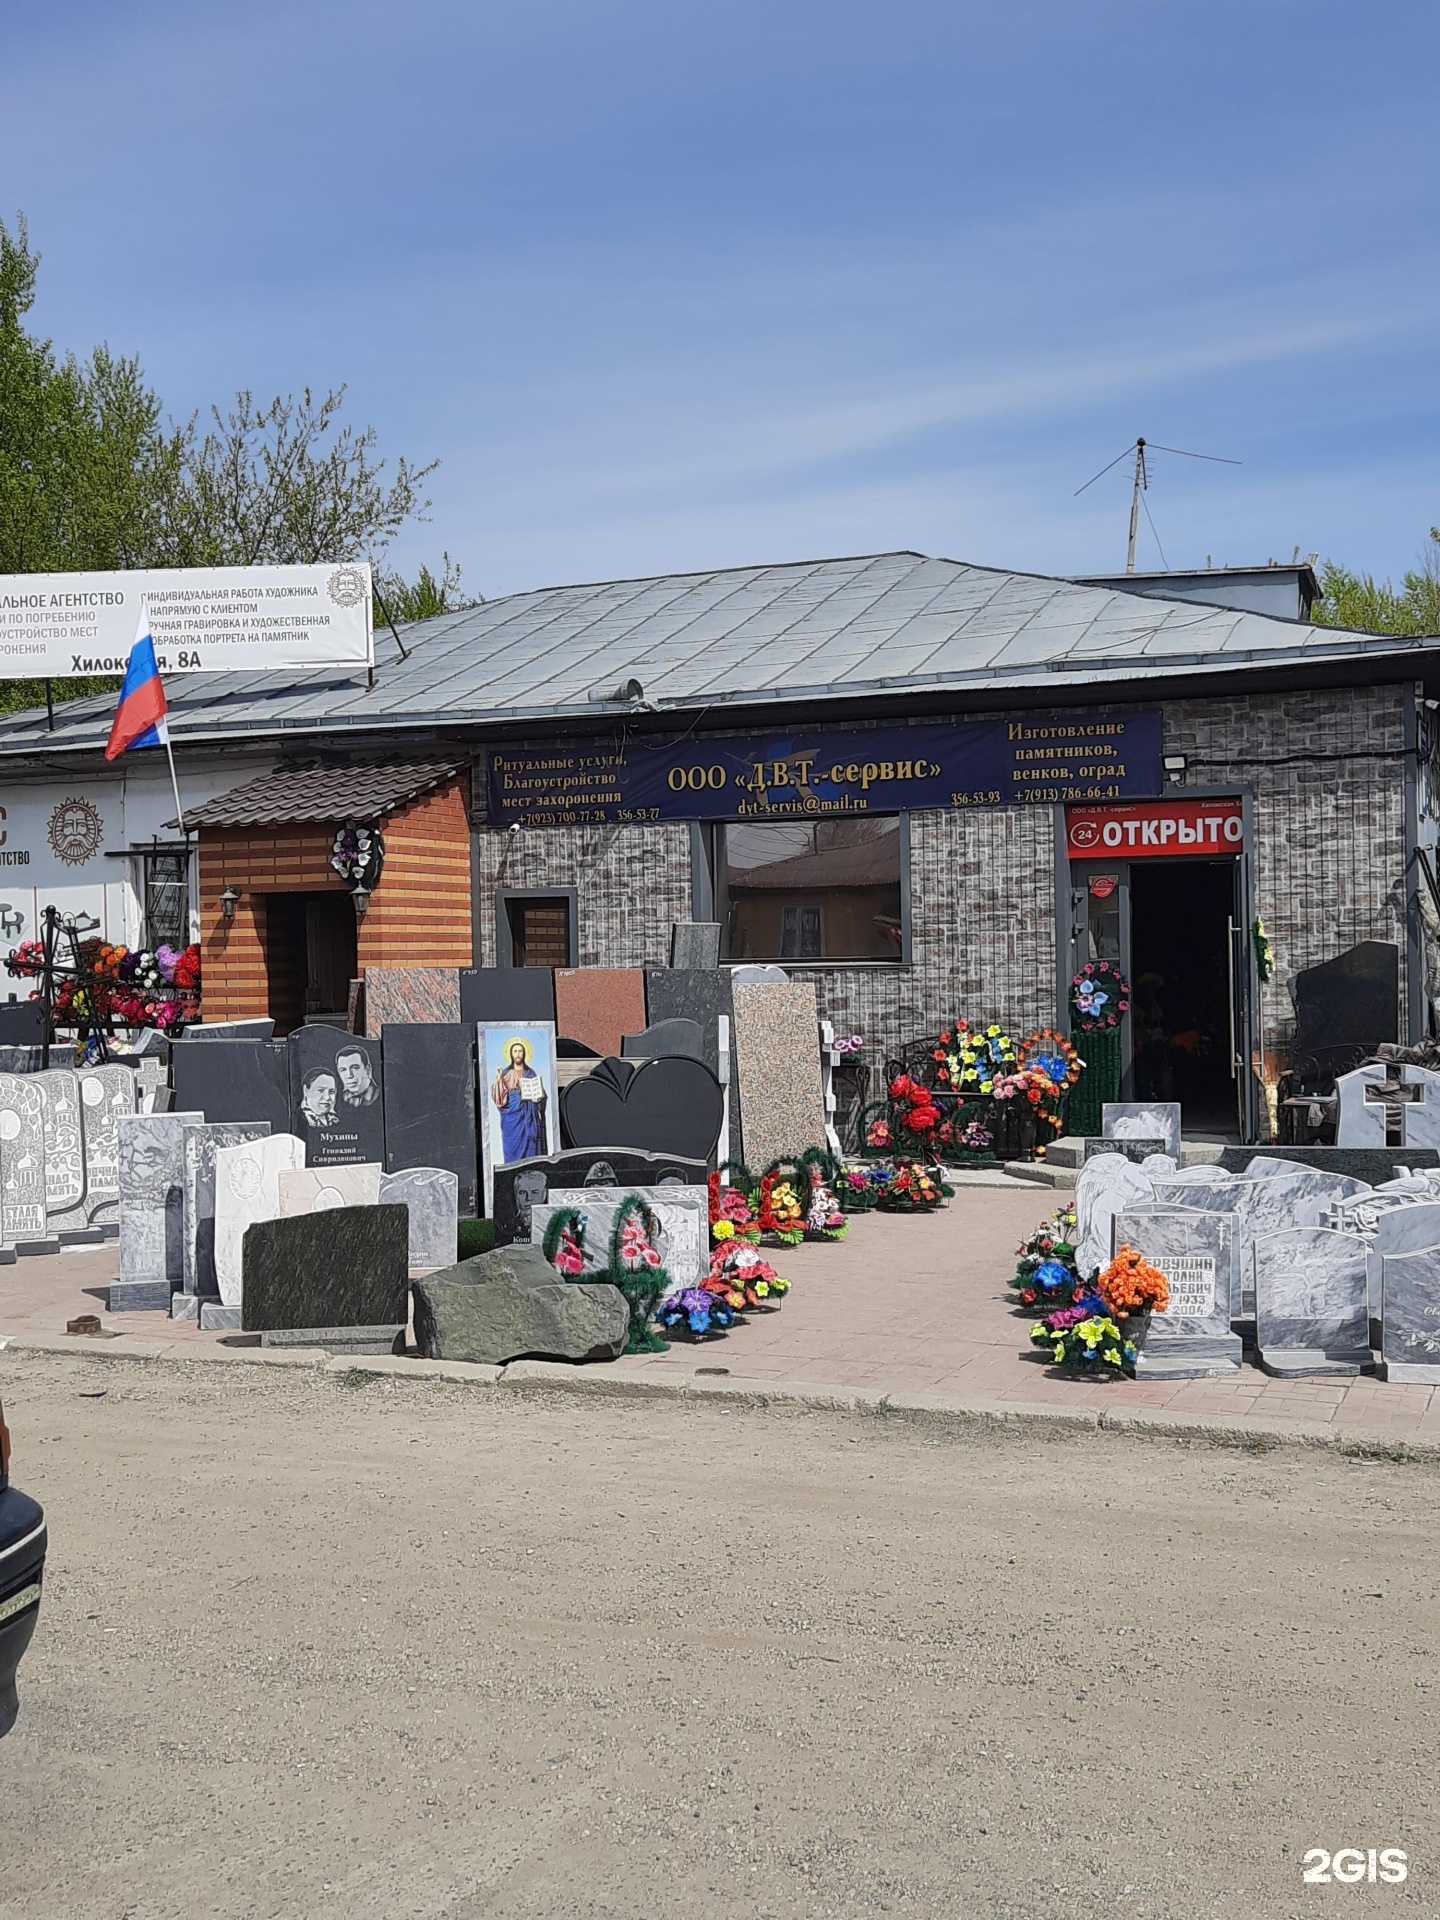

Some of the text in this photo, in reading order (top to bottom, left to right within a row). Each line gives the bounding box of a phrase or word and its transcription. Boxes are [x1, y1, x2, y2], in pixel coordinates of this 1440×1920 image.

[0, 591, 124, 609] ЛЬНОЕ АГЕНТСТВО
[147, 585, 318, 601] ИНДИВИДУАЛЬНАЯ РАБОТА ХУДОЖНИКА
[9, 613, 23, 624] ПО
[26, 611, 96, 624] ПОГРЕБЕНИЮ
[150, 603, 258, 616] НАПРЯМУЮ С КЛИЕНТОМ
[149, 615, 330, 631] РУЧНАЯ ГРАВИРОВКА И ХУДОЖЕСТВЕННАЯ
[70, 626, 98, 638] МЕСТ
[152, 631, 309, 646] ОБРАБОТКА ПОРТРЕТА НА ПАМЯТНИК
[178, 651, 202, 669] 8А
[1008, 722, 1126, 740] Изготовление
[1015, 744, 1118, 761] памятников,
[494, 756, 573, 773] Ритуальные
[1013, 764, 1126, 781] венков, оград
[503, 773, 617, 791] Благоустройство
[667, 765, 727, 791] ООО
[951, 790, 1000, 806] 356-53-93
[1061, 786, 1120, 799] 786-66-41
[502, 793, 622, 809] мест захоронения
[1077, 816, 1243, 848] 24 ОТКРЫТО
[0, 850, 30, 866] ТСТВО
[1147, 1257, 1213, 1271] РВУШИН
